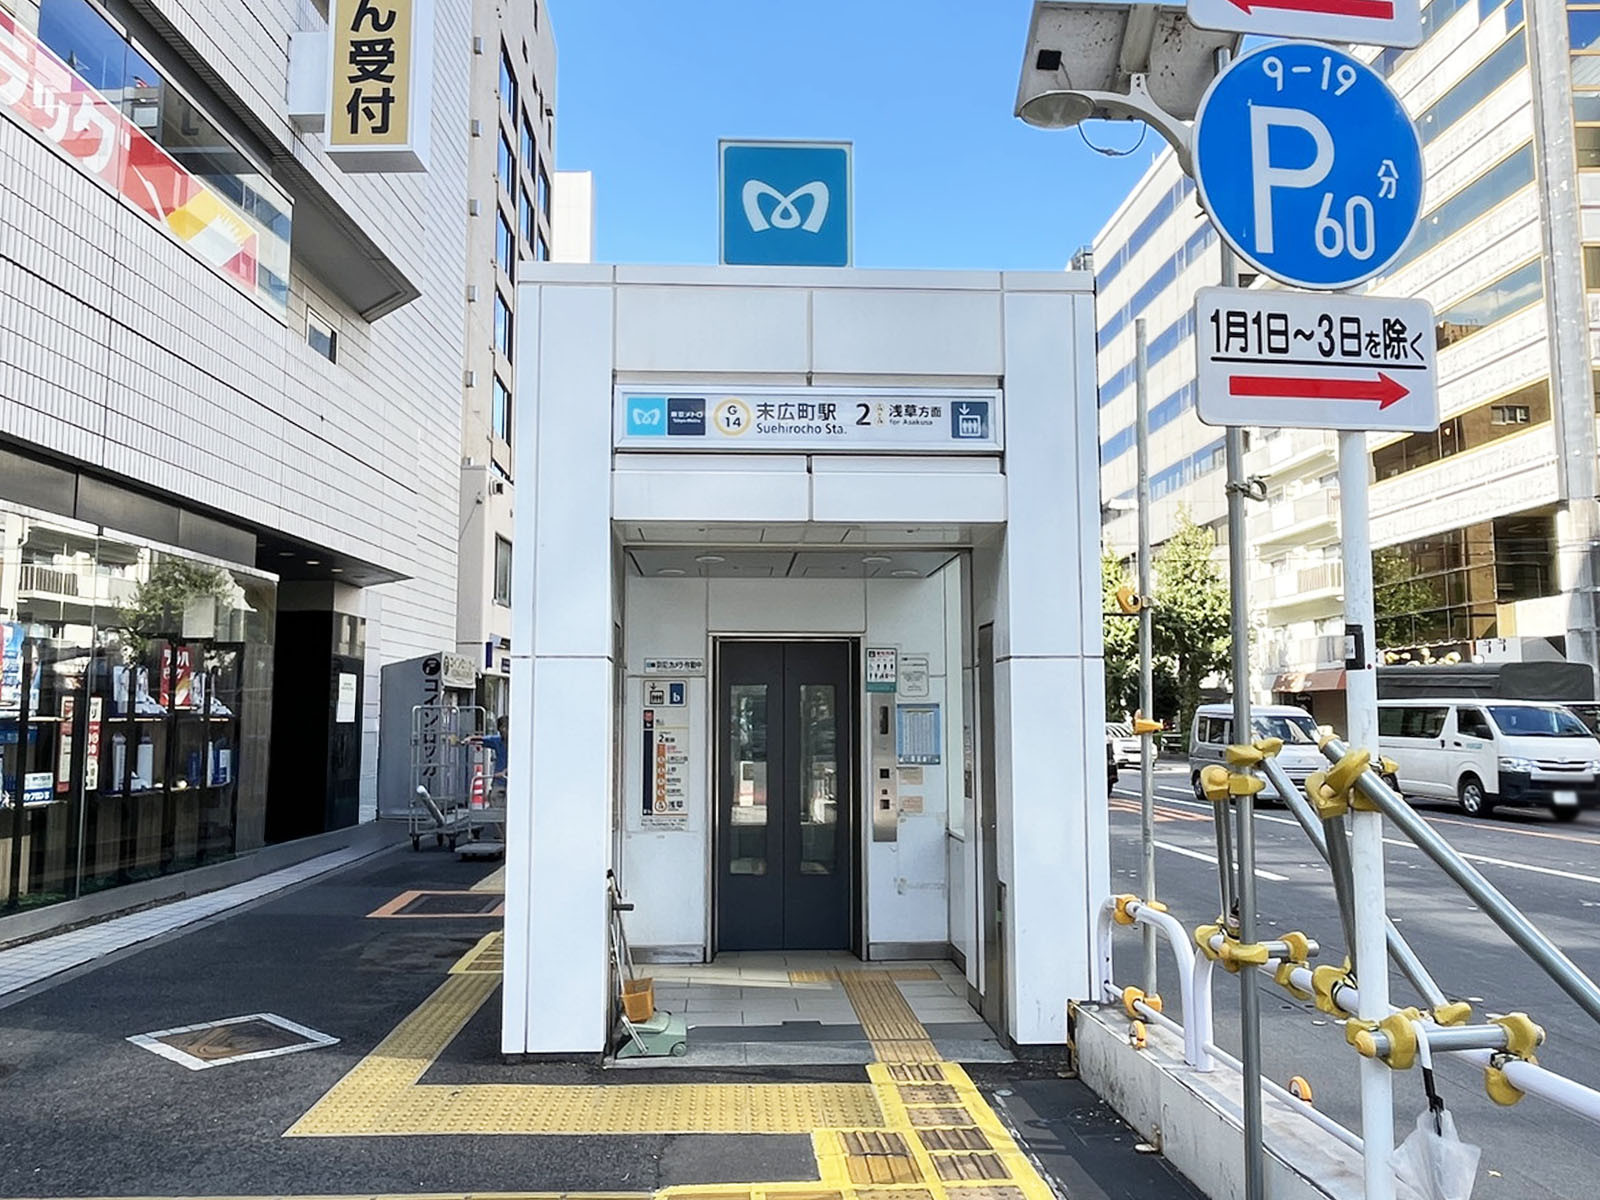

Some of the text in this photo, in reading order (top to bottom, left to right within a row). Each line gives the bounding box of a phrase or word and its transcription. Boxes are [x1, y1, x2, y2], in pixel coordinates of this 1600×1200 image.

[346, 0, 396, 134] ん受付
[1262, 56, 1357, 96] 9-19
[1249, 104, 1335, 254] P
[1377, 159, 1399, 199] 分
[1315, 192, 1376, 260] 60
[727, 405, 737, 415] G
[756, 402, 836, 421] 末広町駅
[856, 403, 871, 425] 2
[889, 404, 941, 418] 浅草方面
[725, 417, 741, 428] 14
[756, 423, 847, 434] Suehirocho Sta.
